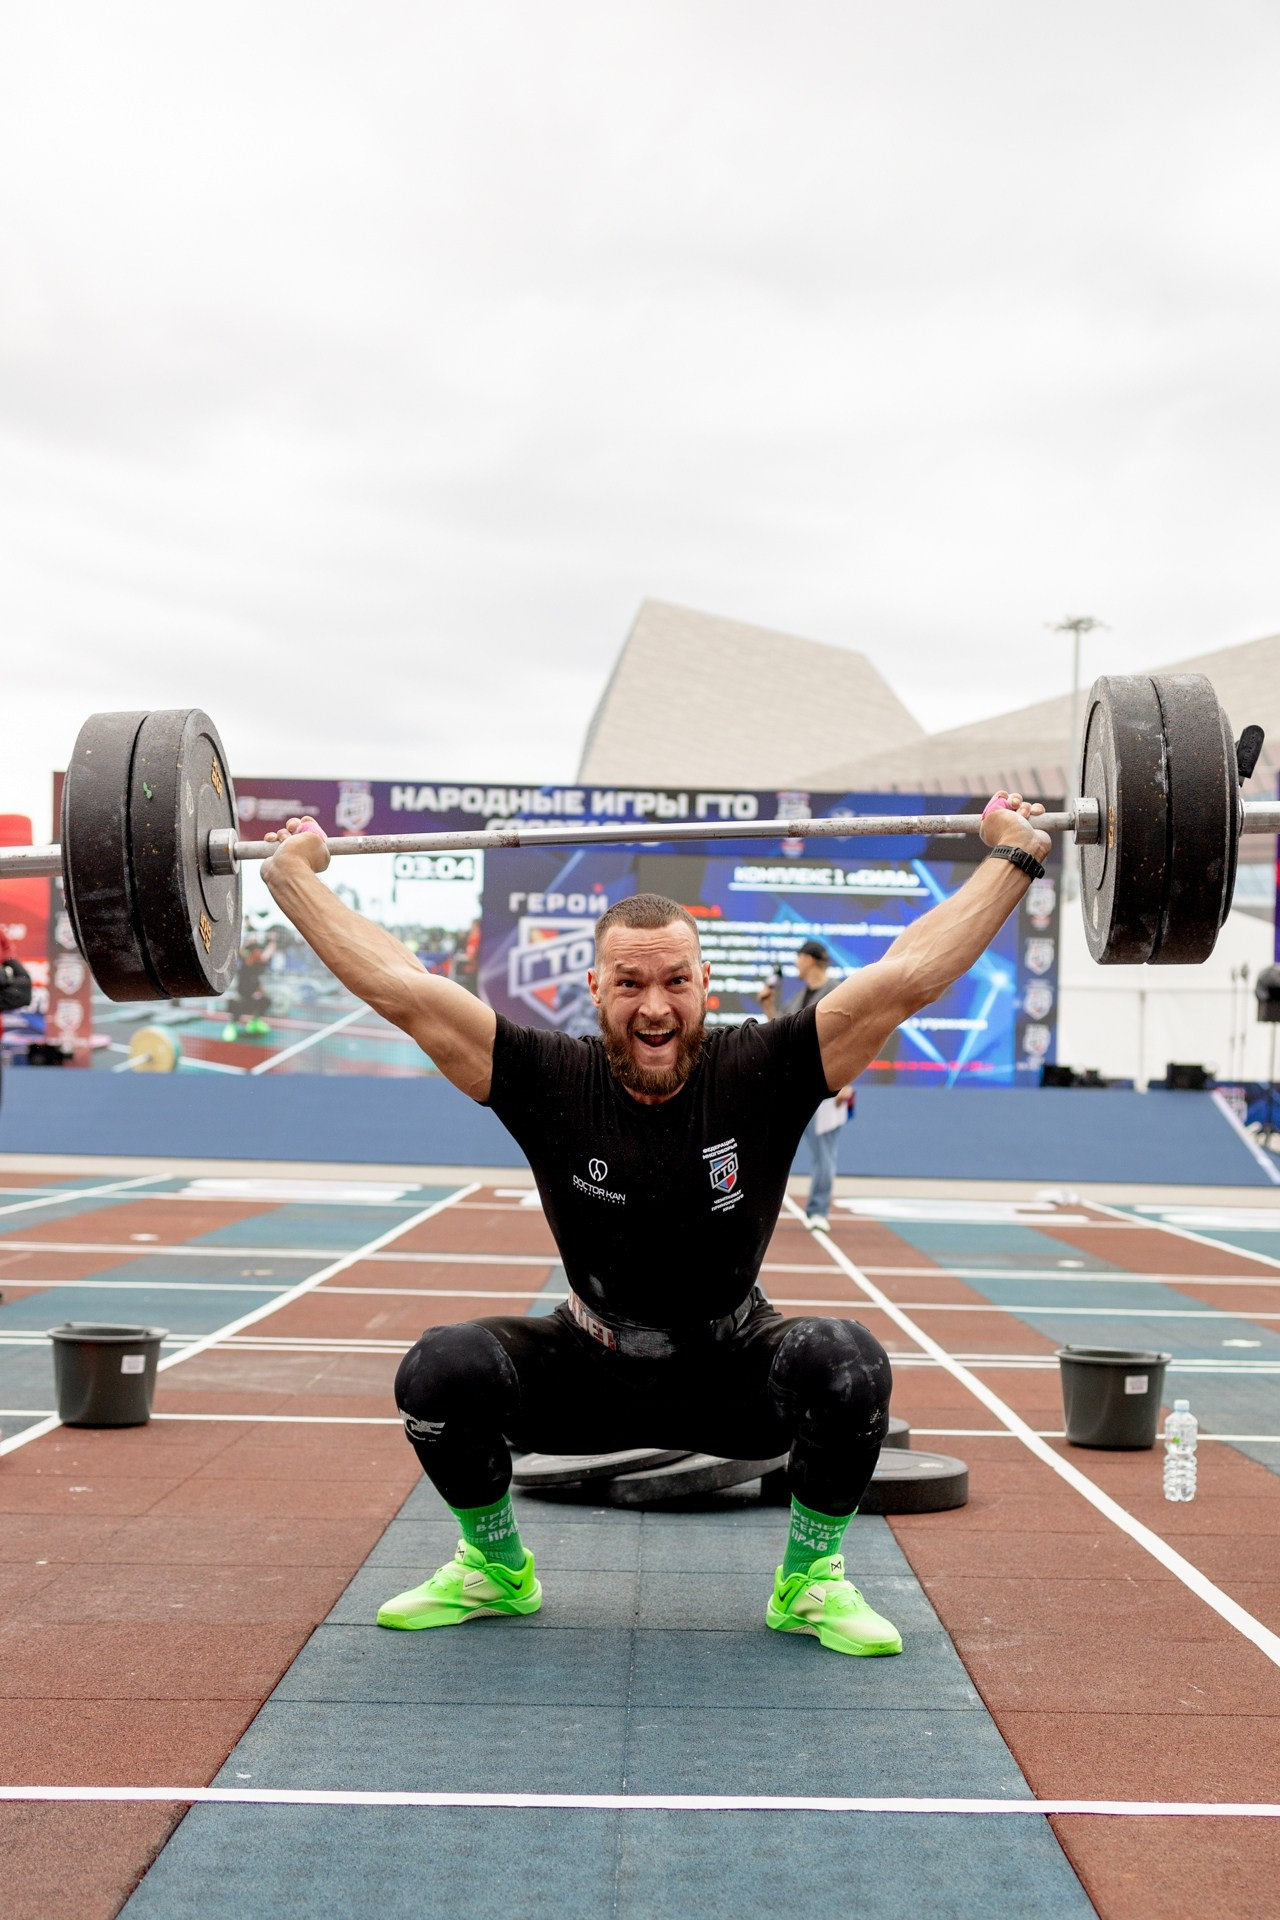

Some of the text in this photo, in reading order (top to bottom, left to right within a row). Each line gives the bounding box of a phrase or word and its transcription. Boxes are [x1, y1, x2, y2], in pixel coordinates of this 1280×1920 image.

[390, 785, 585, 818] НАРОДНЫЕ
[591, 790, 689, 818] ИГРЫ
[695, 793, 759, 820] ГТО
[394, 854, 474, 879] 03:04
[509, 884, 608, 914] ГЕРОЙ
[522, 941, 595, 984] ГТО
[702, 1137, 736, 1154] ФЕДЕРАЦИЯ
[702, 1142, 738, 1160] МНОГОБОРЬЯ
[714, 1160, 735, 1183] ГТО
[573, 1174, 605, 1197] DOCTOR
[605, 1190, 626, 1202] KAN
[791, 1503, 845, 1531] РЕНЕР
[791, 1519, 841, 1540] СЕГДА
[792, 1527, 828, 1551] ПРАВ
